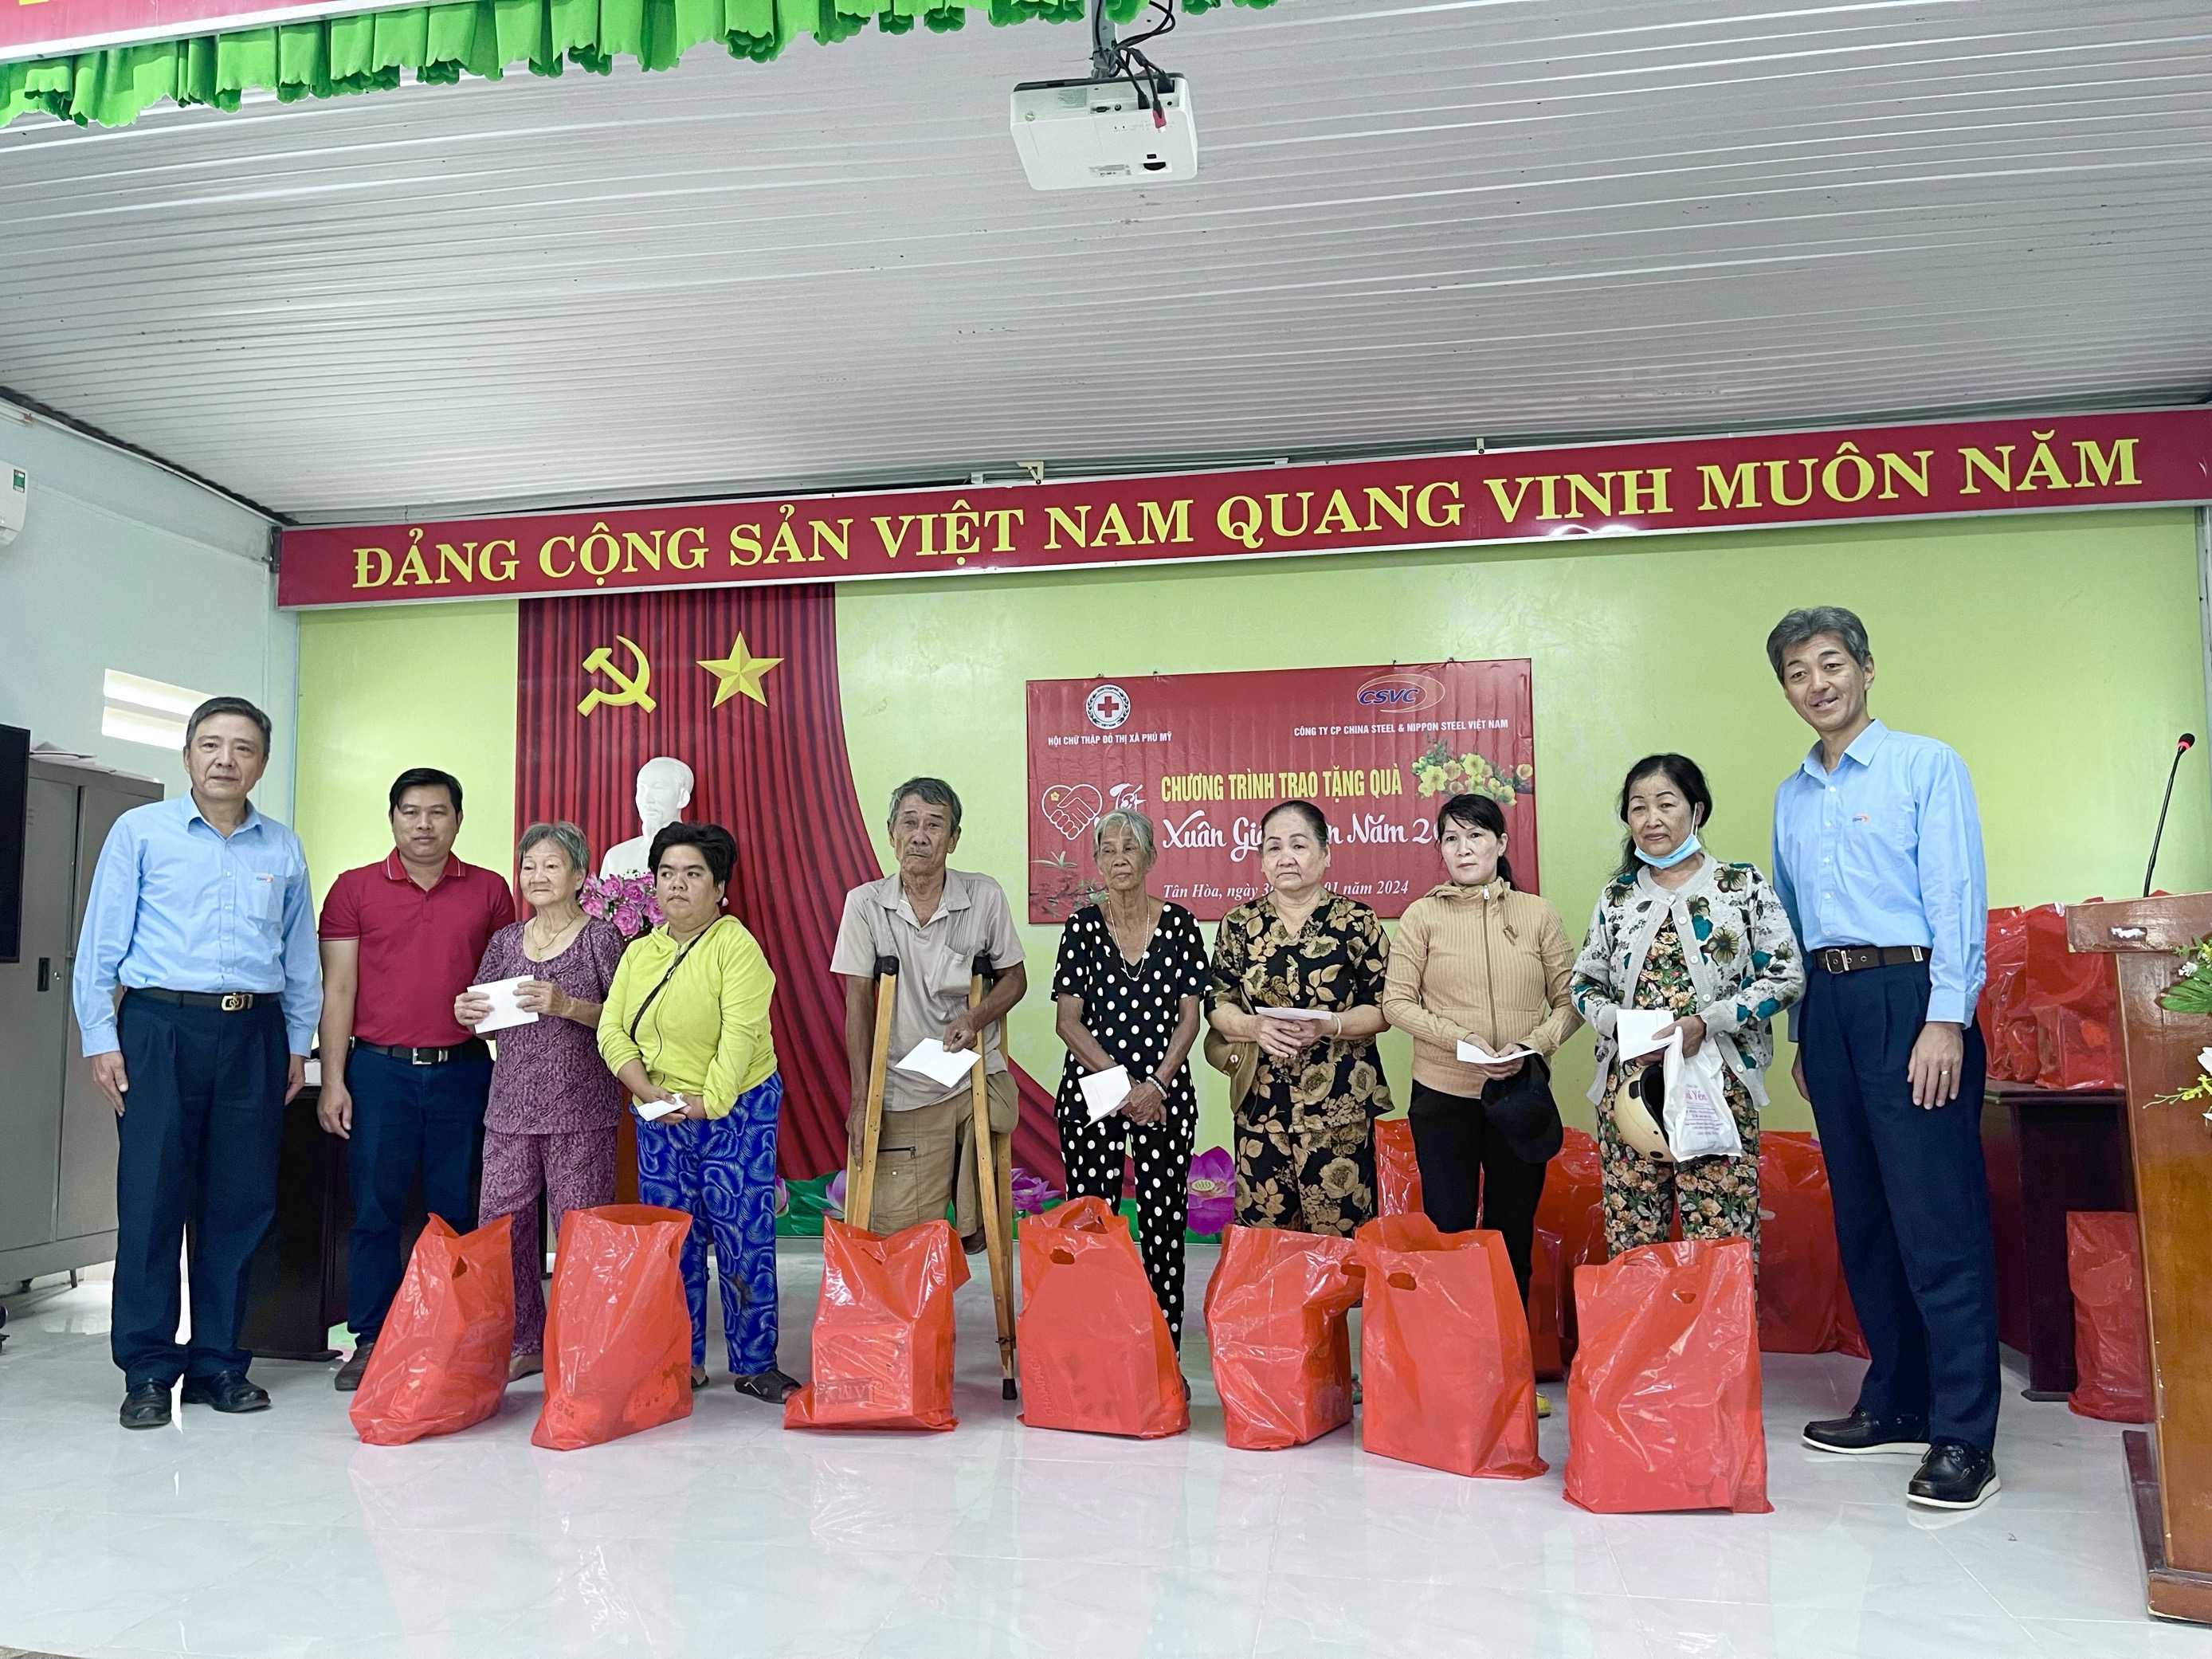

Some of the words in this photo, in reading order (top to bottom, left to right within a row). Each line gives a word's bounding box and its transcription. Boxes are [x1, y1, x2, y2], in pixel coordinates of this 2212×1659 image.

[352, 528, 520, 588] ĐẢNG
[539, 522, 708, 586] CỘNG
[730, 504, 853, 567] SẢN
[871, 499, 1024, 566] VIỆT
[1043, 499, 1195, 551] NAM
[1217, 481, 1465, 549] QUANG
[1484, 468, 1673, 524] VINH
[1697, 441, 1934, 512] MUÔN
[1959, 430, 2143, 495] NĂM
[1359, 688, 1418, 705] CSVC
[1294, 726, 1316, 736] CÔNG
[1318, 726, 1328, 735] TY
[1330, 726, 1341, 735] CP
[1343, 725, 1369, 735] CHINA
[1371, 724, 1395, 734] STEEL
[1398, 724, 1404, 732] &
[1406, 722, 1438, 732] NIPPON
[1441, 720, 1466, 731] STEEL
[1468, 719, 1485, 731] VIỆT
[1488, 720, 1508, 728] NAM
[1048, 735, 1061, 747] HỘI
[1063, 735, 1079, 745] CHỮ
[1081, 734, 1100, 746] THẬP
[1116, 733, 1127, 744] THỊ
[1161, 773, 1223, 802] CHƯƠNG
[1228, 768, 1274, 799] TRÌNH
[1279, 771, 1318, 798] TRAO
[1323, 765, 1364, 802] TẶNG
[1370, 763, 1402, 798] QUÀ
[1162, 810, 1227, 848] Xuân
[1347, 813, 1409, 843] Năm
[1163, 884, 1188, 898] Tân
[1192, 884, 1222, 900] Hòa,
[1227, 883, 1257, 900] ngày
[1343, 880, 1371, 895] năm
[1376, 880, 1409, 894] 2024
